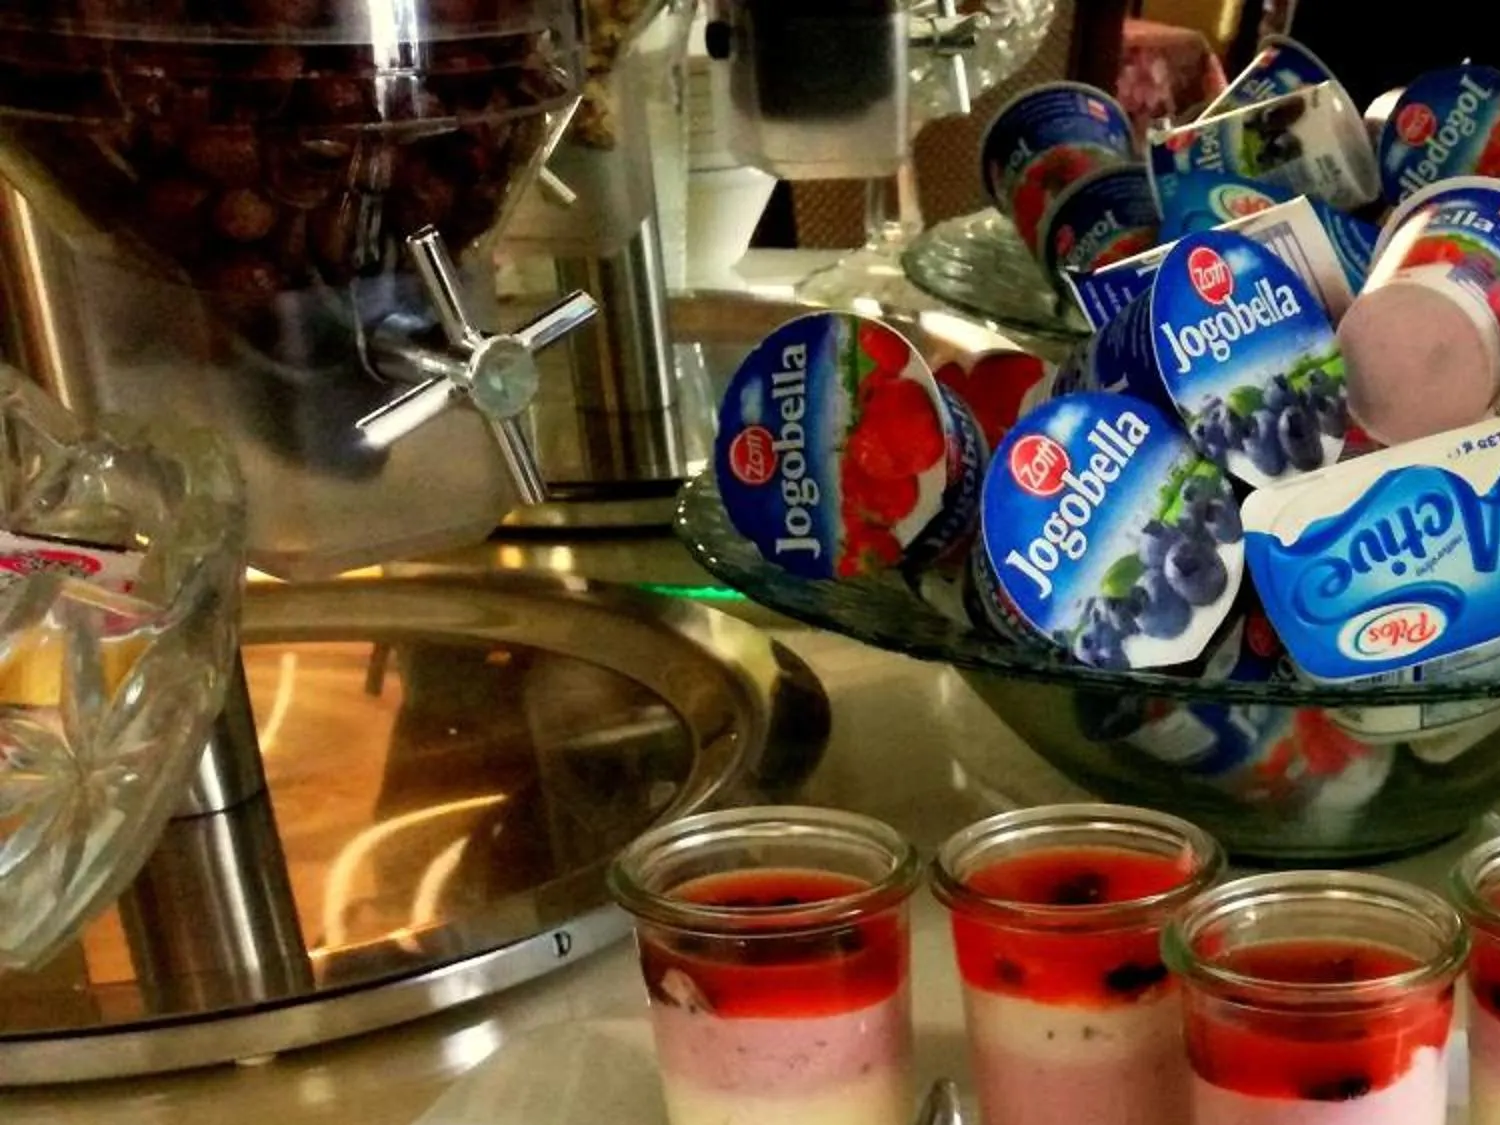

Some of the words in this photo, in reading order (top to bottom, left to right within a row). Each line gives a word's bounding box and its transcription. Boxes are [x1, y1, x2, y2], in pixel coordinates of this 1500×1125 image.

[1160, 277, 1301, 374] Jogobella
[772, 343, 821, 560] Jogobella
[1021, 440, 1058, 489] Zott
[1005, 411, 1150, 600] Jogobella
[1367, 611, 1439, 646] Pilos
